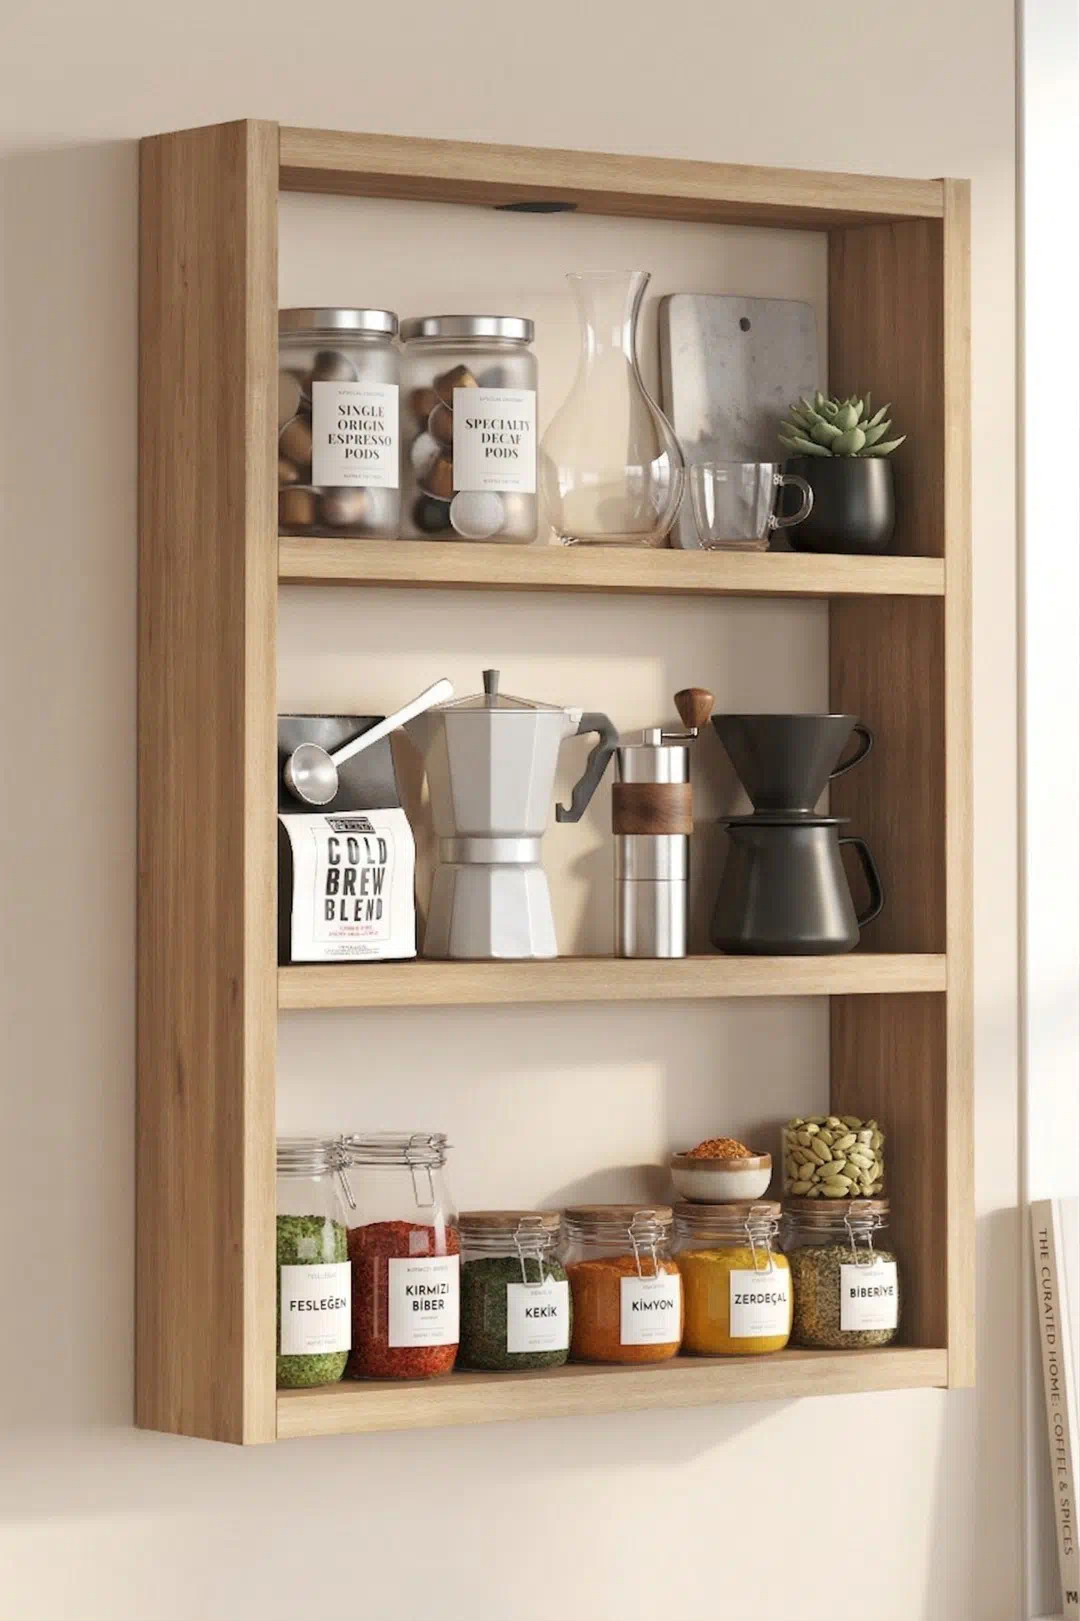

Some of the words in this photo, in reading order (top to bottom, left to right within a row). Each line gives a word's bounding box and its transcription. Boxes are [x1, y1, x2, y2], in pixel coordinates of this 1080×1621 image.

[338, 405, 384, 418] SINGLE
[337, 419, 384, 431] ORIGIN
[465, 418, 531, 431] SPECIALTY
[328, 433, 392, 446] ESPRESSO
[481, 433, 521, 445] DECAF
[345, 448, 380, 460] PODS
[485, 447, 519, 459] PODS
[327, 837, 388, 865] COLD
[325, 867, 386, 896] BREW
[324, 898, 384, 921] BLEND
[1038, 1228, 1049, 1260] THE
[405, 1284, 450, 1296] KIRMIZI
[289, 1295, 347, 1312] FESLEĞEN
[412, 1298, 445, 1312] BİBER
[631, 1298, 674, 1312] KİMYON
[734, 1292, 787, 1306] ZERDEÇAL
[1041, 1266, 1056, 1345] CURATED
[525, 1304, 558, 1318] KEKİK
[1048, 1351, 1061, 1407] HOME:
[1053, 1412, 1067, 1474] COFFEE
[1059, 1481, 1068, 1491] &
[1060, 1499, 1073, 1556] SPICES
